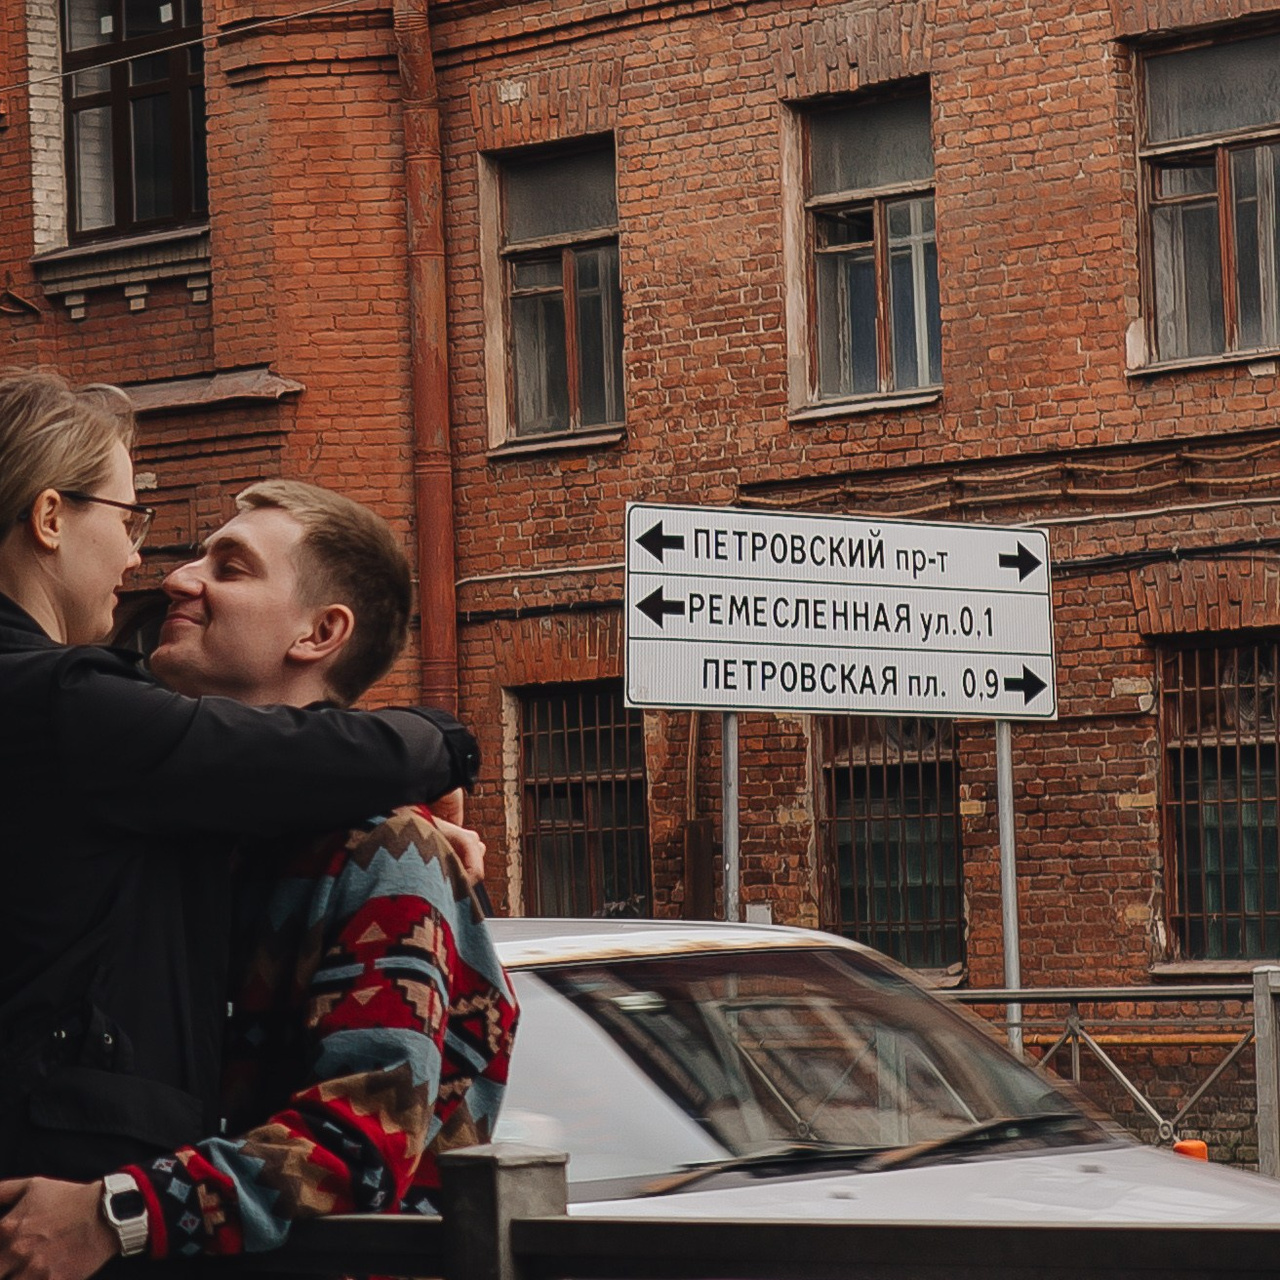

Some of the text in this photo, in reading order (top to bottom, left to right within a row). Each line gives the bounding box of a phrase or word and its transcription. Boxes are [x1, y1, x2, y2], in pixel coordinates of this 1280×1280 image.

[694, 528, 948, 580] ПЕТРОВСКИЙ пр-т
[689, 592, 911, 634] РЕМЕСЛЕННАЯ
[703, 658, 999, 701] ПЕТРОВСКАЯ пл. 0,9
